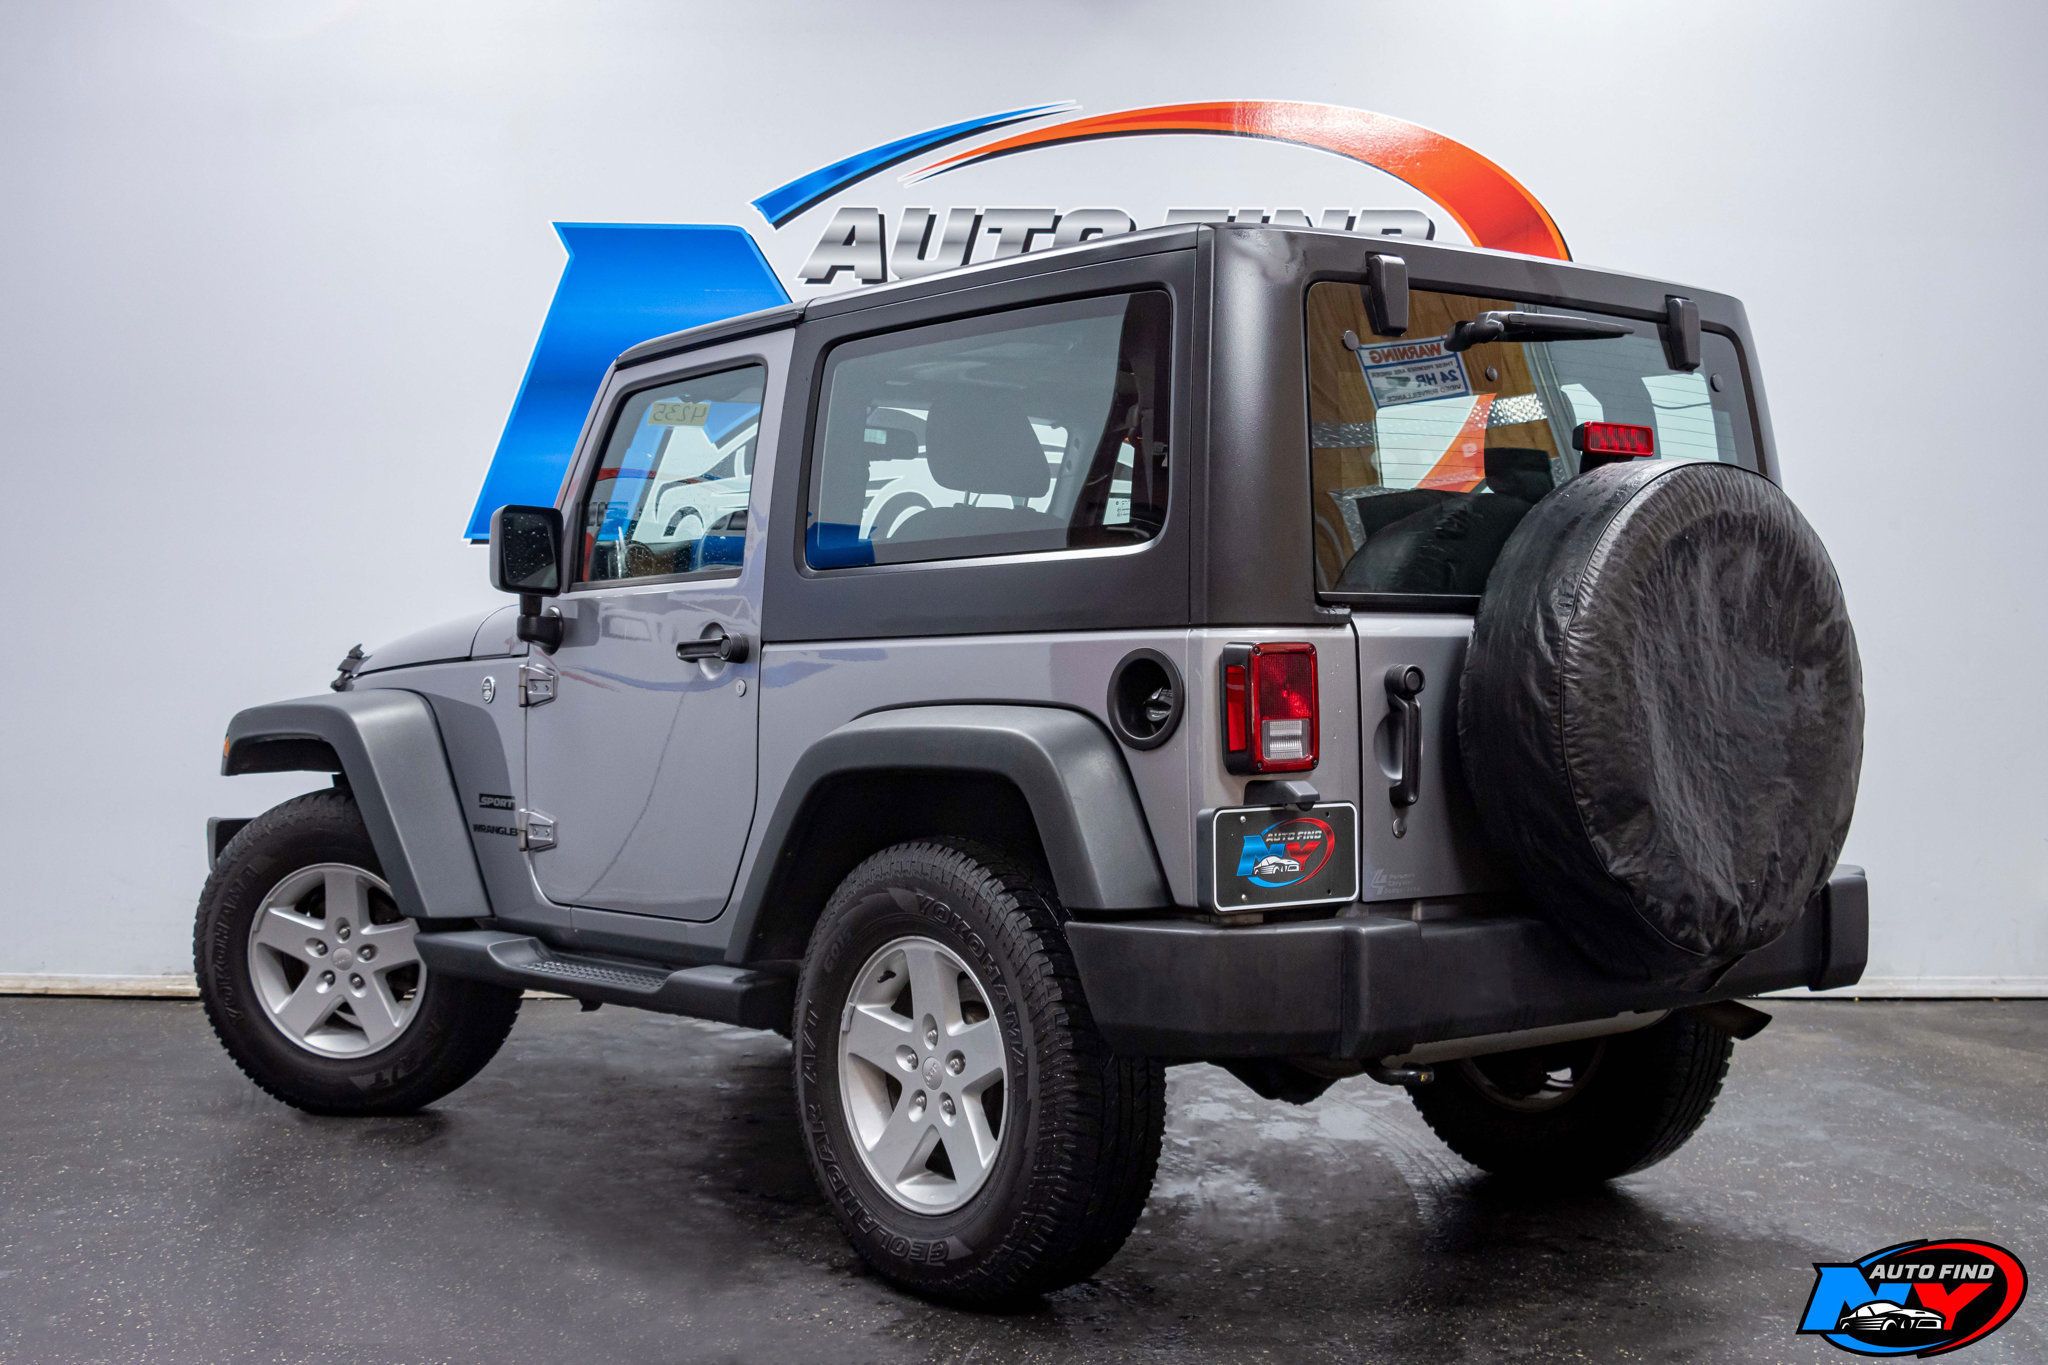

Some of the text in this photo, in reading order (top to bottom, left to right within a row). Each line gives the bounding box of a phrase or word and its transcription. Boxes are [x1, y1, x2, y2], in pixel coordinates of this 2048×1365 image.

[480, 796, 514, 808] SPORT
[1266, 830, 1322, 842] AUTO FIND
[915, 888, 1025, 1077] YOKOHAMA
[807, 1104, 950, 1266] GEOLANDAR
